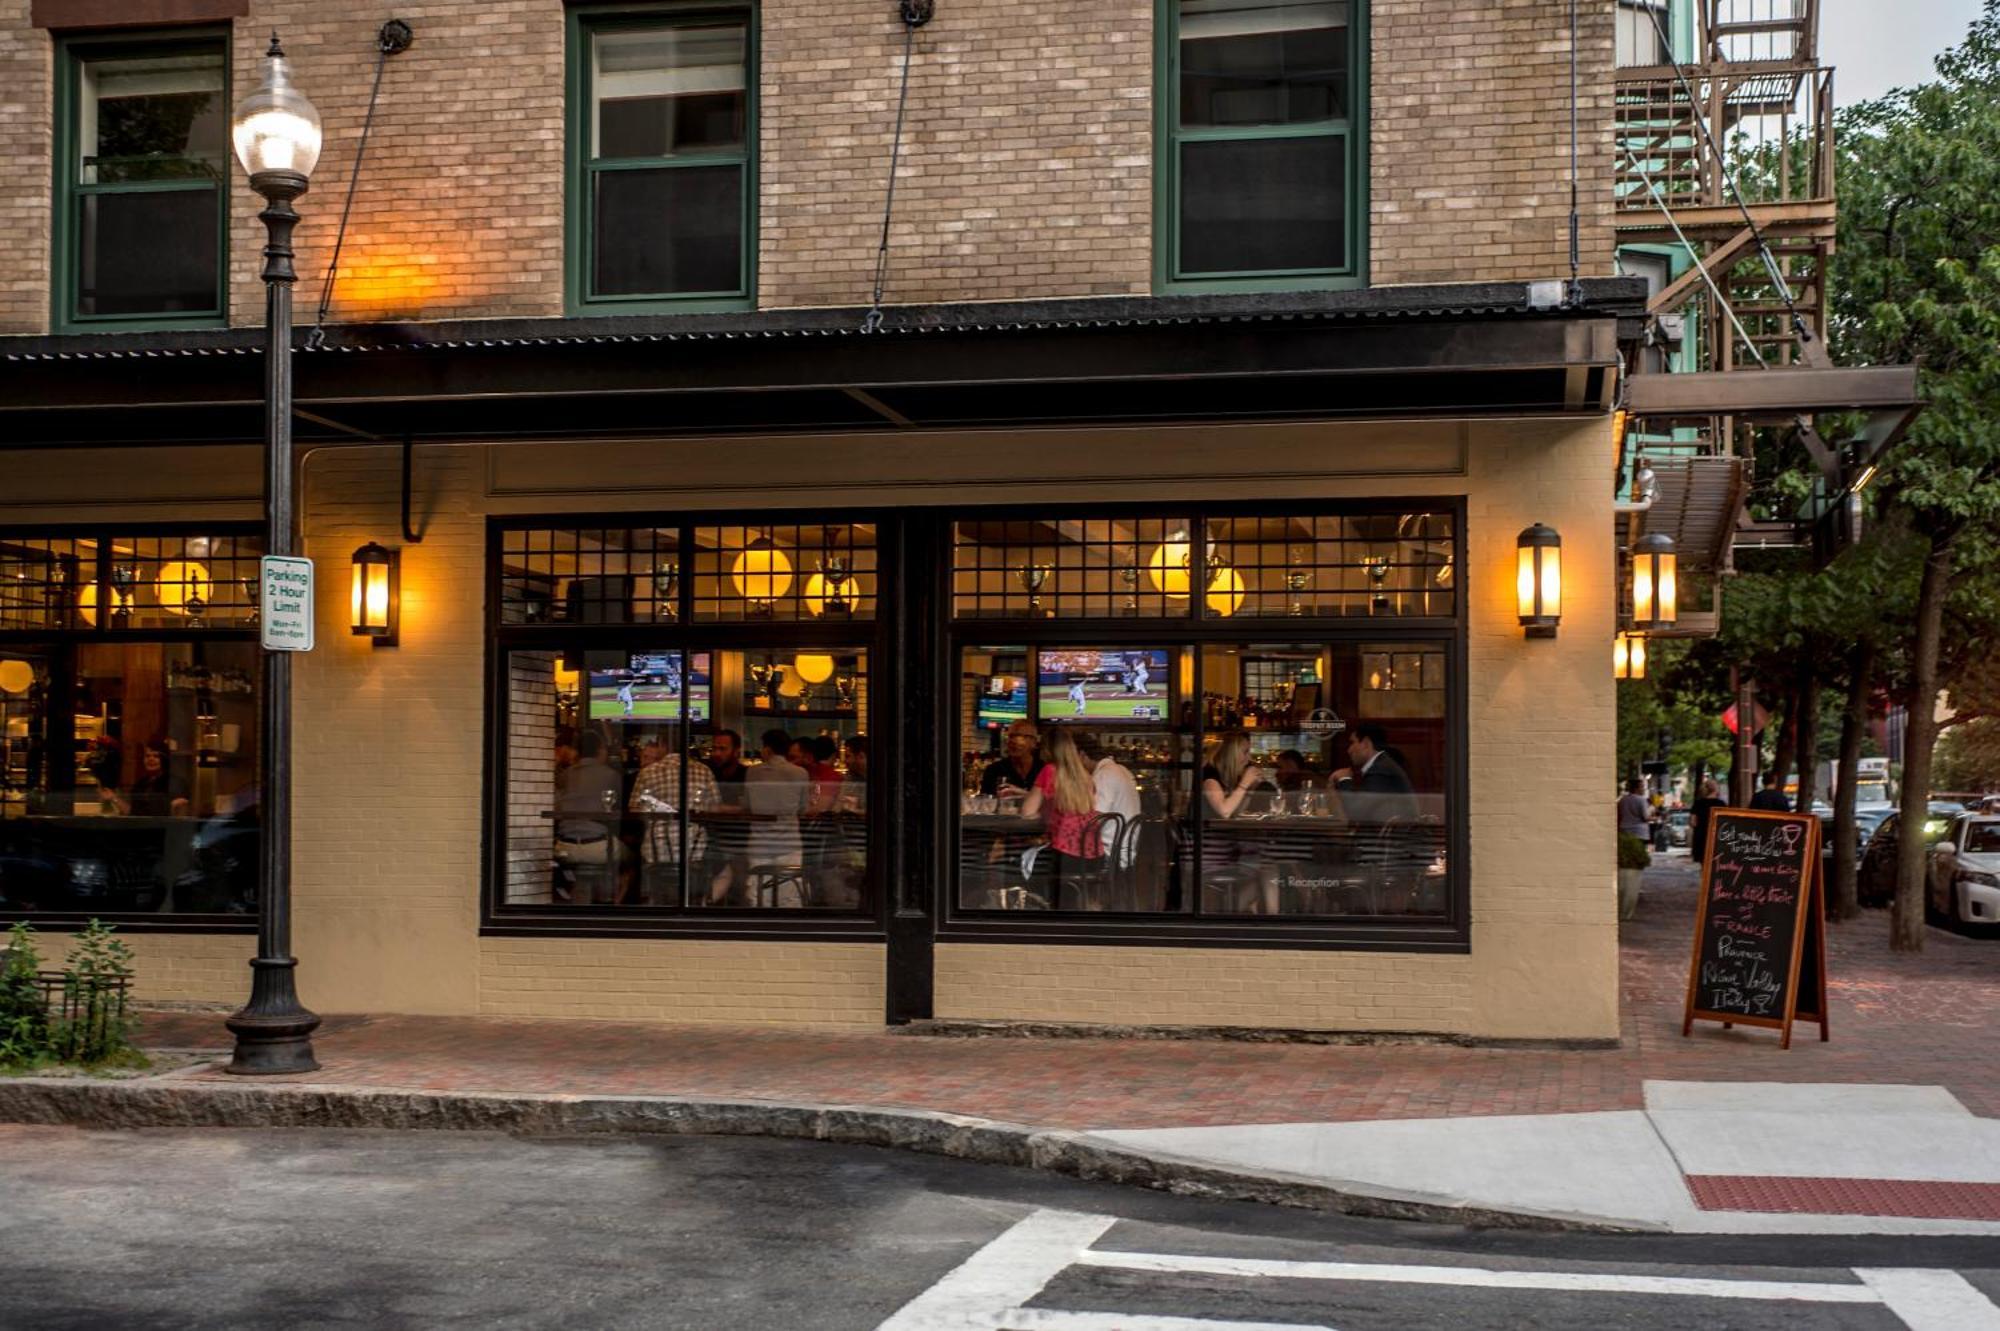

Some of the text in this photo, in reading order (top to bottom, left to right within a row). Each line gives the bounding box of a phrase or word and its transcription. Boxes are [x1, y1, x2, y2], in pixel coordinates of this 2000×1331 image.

[267, 568, 308, 586] Parking
[269, 584, 306, 598] 2 Hour
[273, 600, 300, 613] Limit
[1288, 876, 1340, 889] Reception
[1713, 914, 1773, 938] FRANCE
